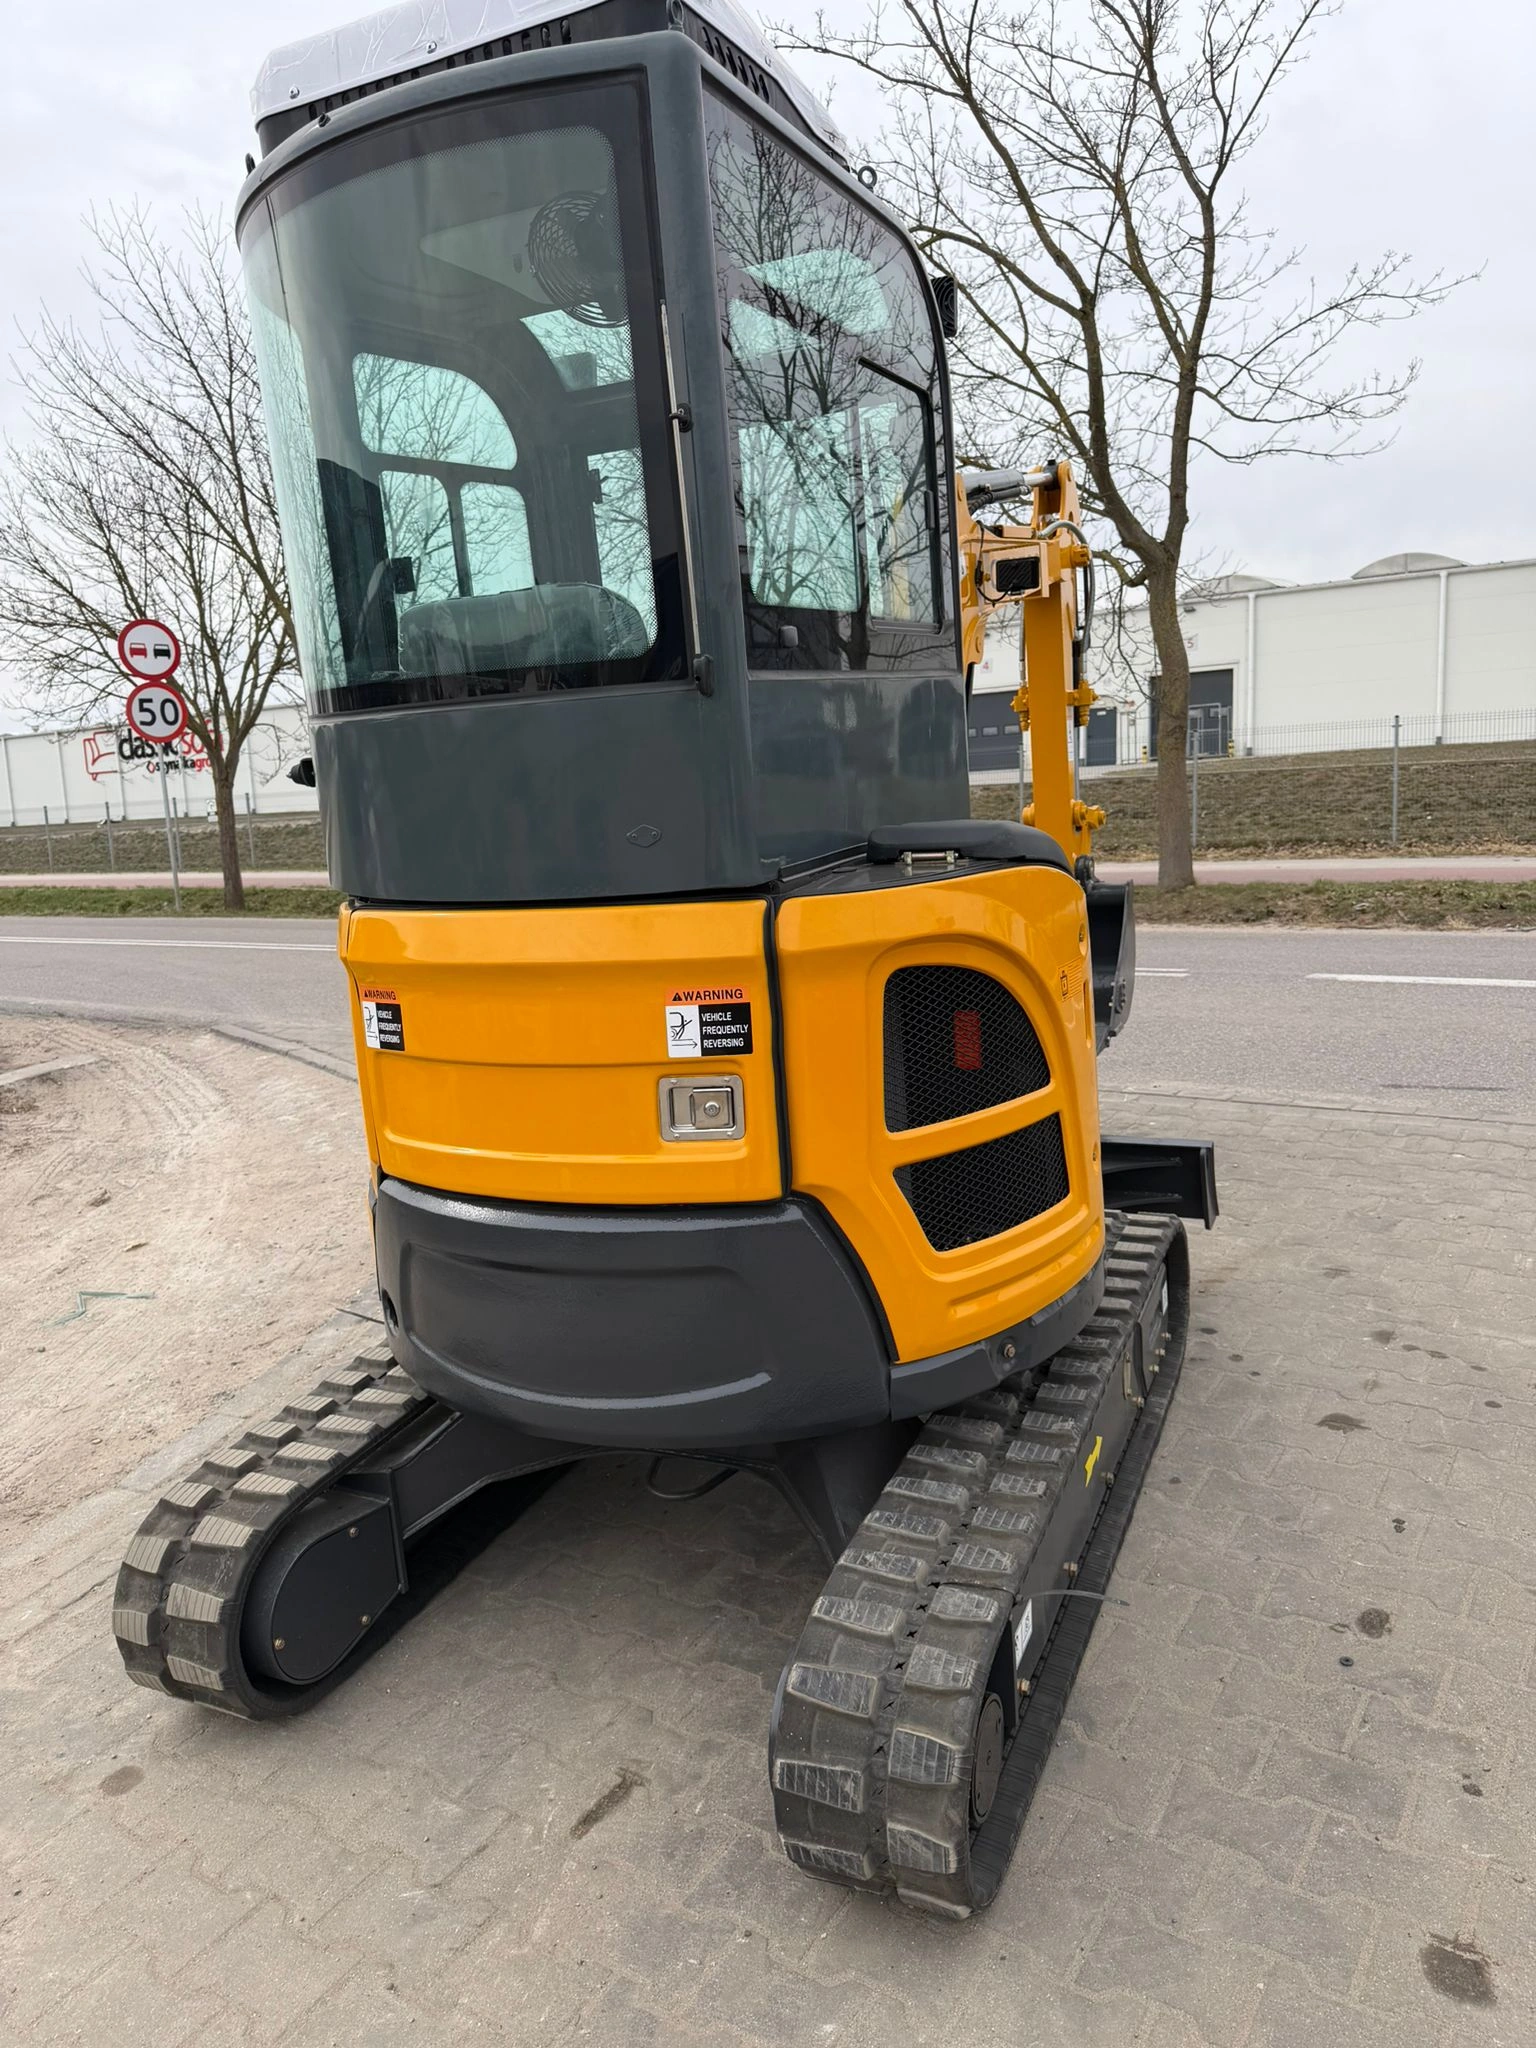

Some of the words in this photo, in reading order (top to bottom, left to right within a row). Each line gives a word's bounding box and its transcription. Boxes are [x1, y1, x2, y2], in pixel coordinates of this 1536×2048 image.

[138, 698, 180, 726] 50
[367, 989, 397, 1001] WARNING
[682, 988, 744, 1002] WARNING
[701, 1012, 732, 1022] VEHICLE
[702, 1024, 749, 1036] FREQUENTLY
[703, 1038, 744, 1049] REVERSING
